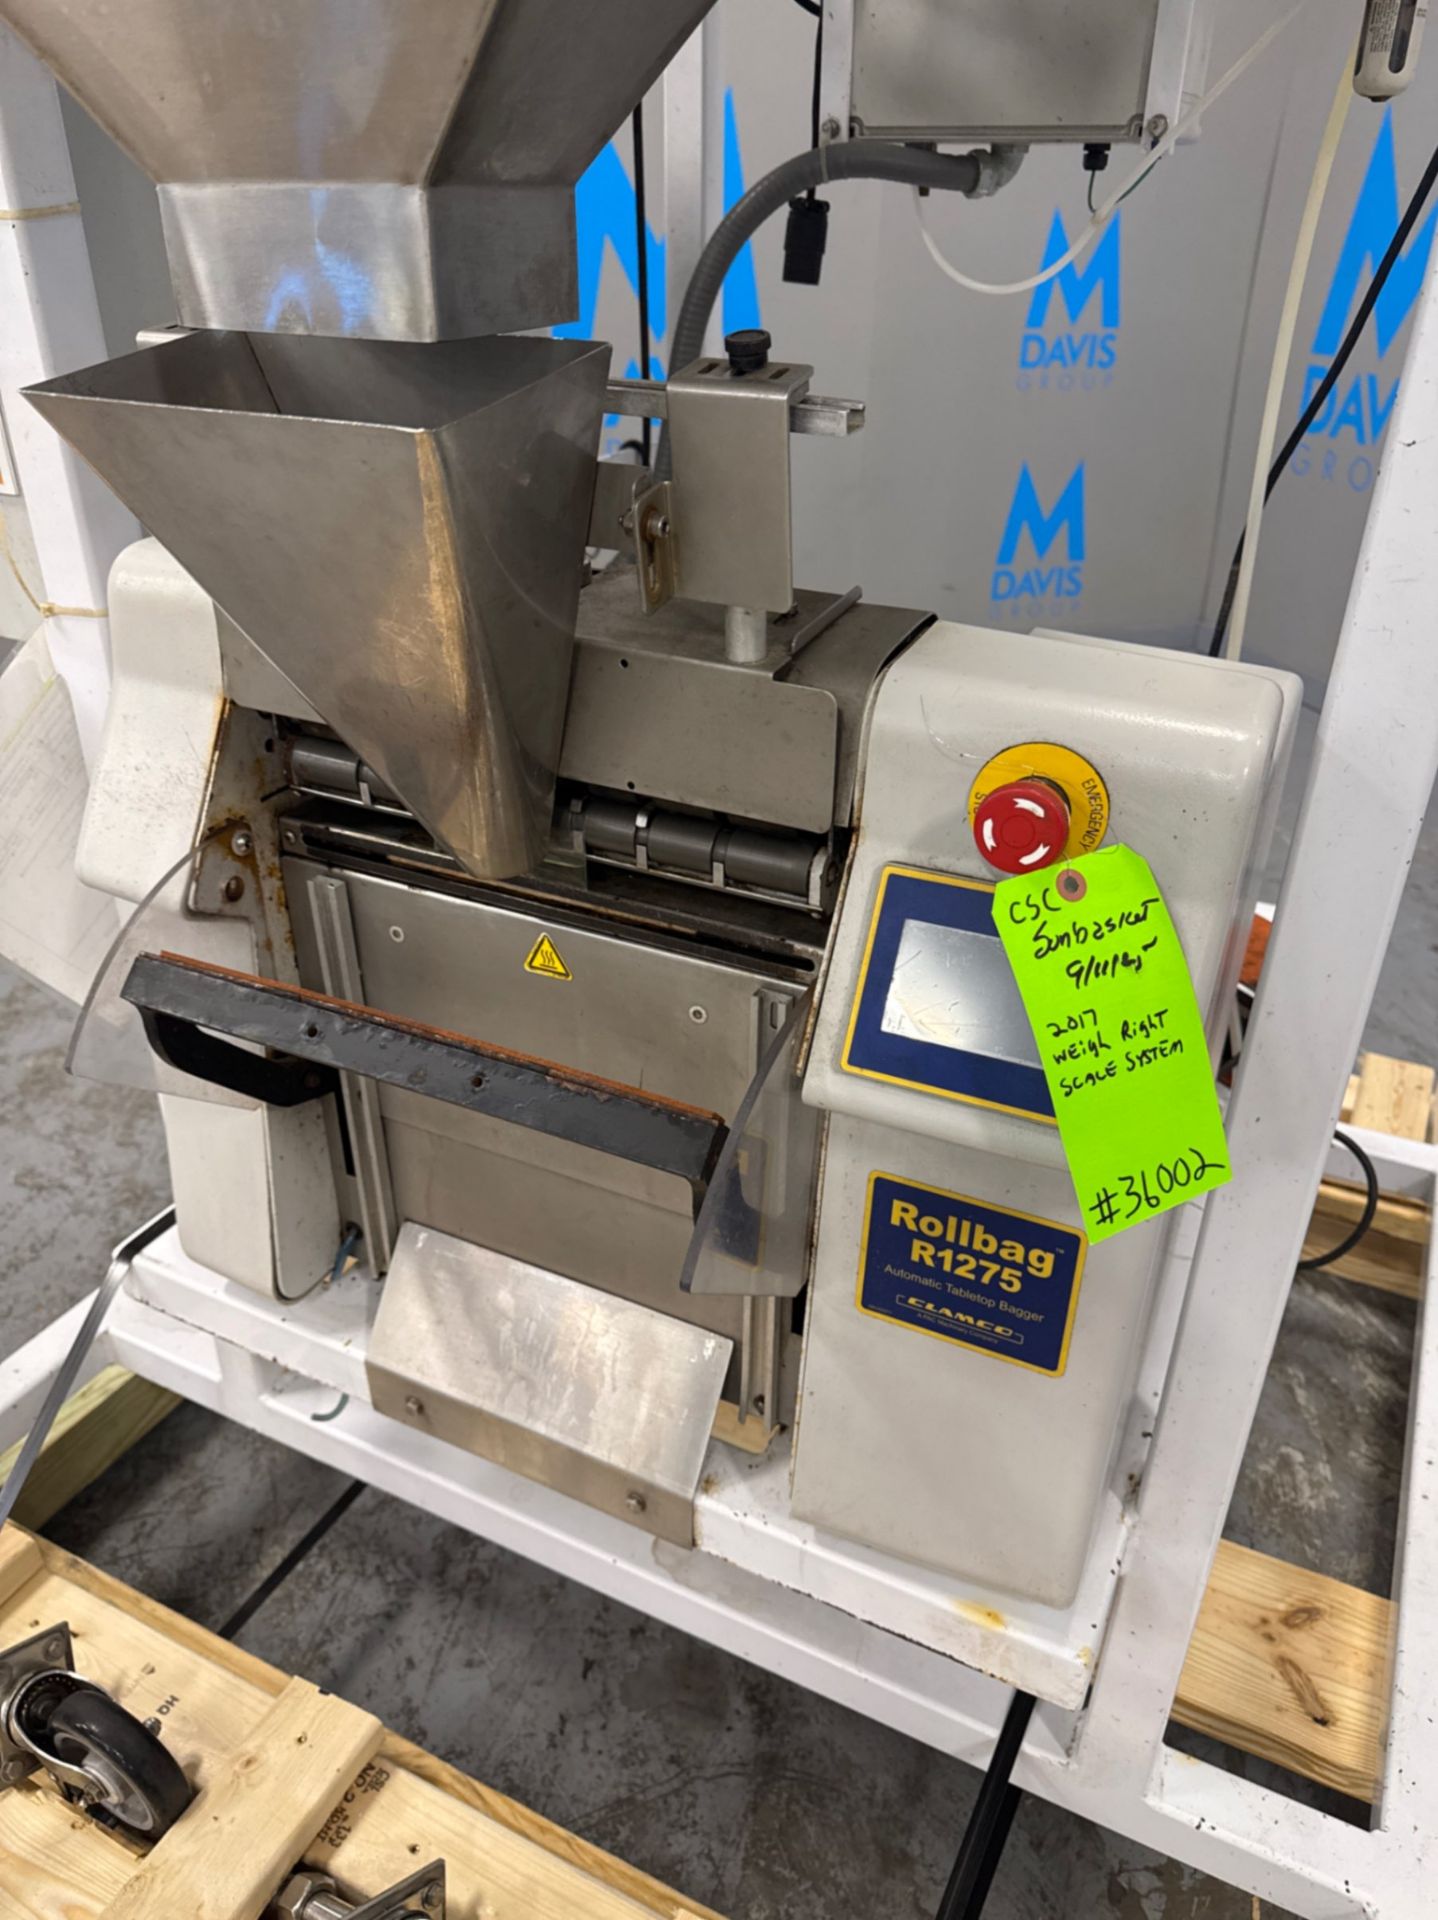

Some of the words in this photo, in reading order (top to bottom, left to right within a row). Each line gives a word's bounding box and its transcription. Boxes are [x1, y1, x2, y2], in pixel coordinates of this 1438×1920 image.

[1026, 205, 1120, 328] M
[1019, 333, 1117, 369] DAVIS
[1298, 364, 1401, 446] DAV
[1290, 442, 1374, 493] GRO
[996, 458, 1085, 565] M
[990, 566, 1083, 601] DAVIS
[1078, 778, 1104, 852] EMERGENCY
[1009, 887, 1061, 924] CSC
[1047, 1009, 1098, 1037] 2017
[1060, 1061, 1117, 1098] SCALE
[1125, 1039, 1183, 1072] SYSTEM
[1089, 1148, 1225, 1225] #36002
[890, 1199, 1055, 1279] Rollbag
[910, 1238, 1022, 1294] R1275
[883, 1264, 942, 1290] Automatic
[945, 1282, 996, 1309] Tabletop
[998, 1300, 1045, 1323] Bagger
[907, 1296, 1013, 1337] CLAMCO
